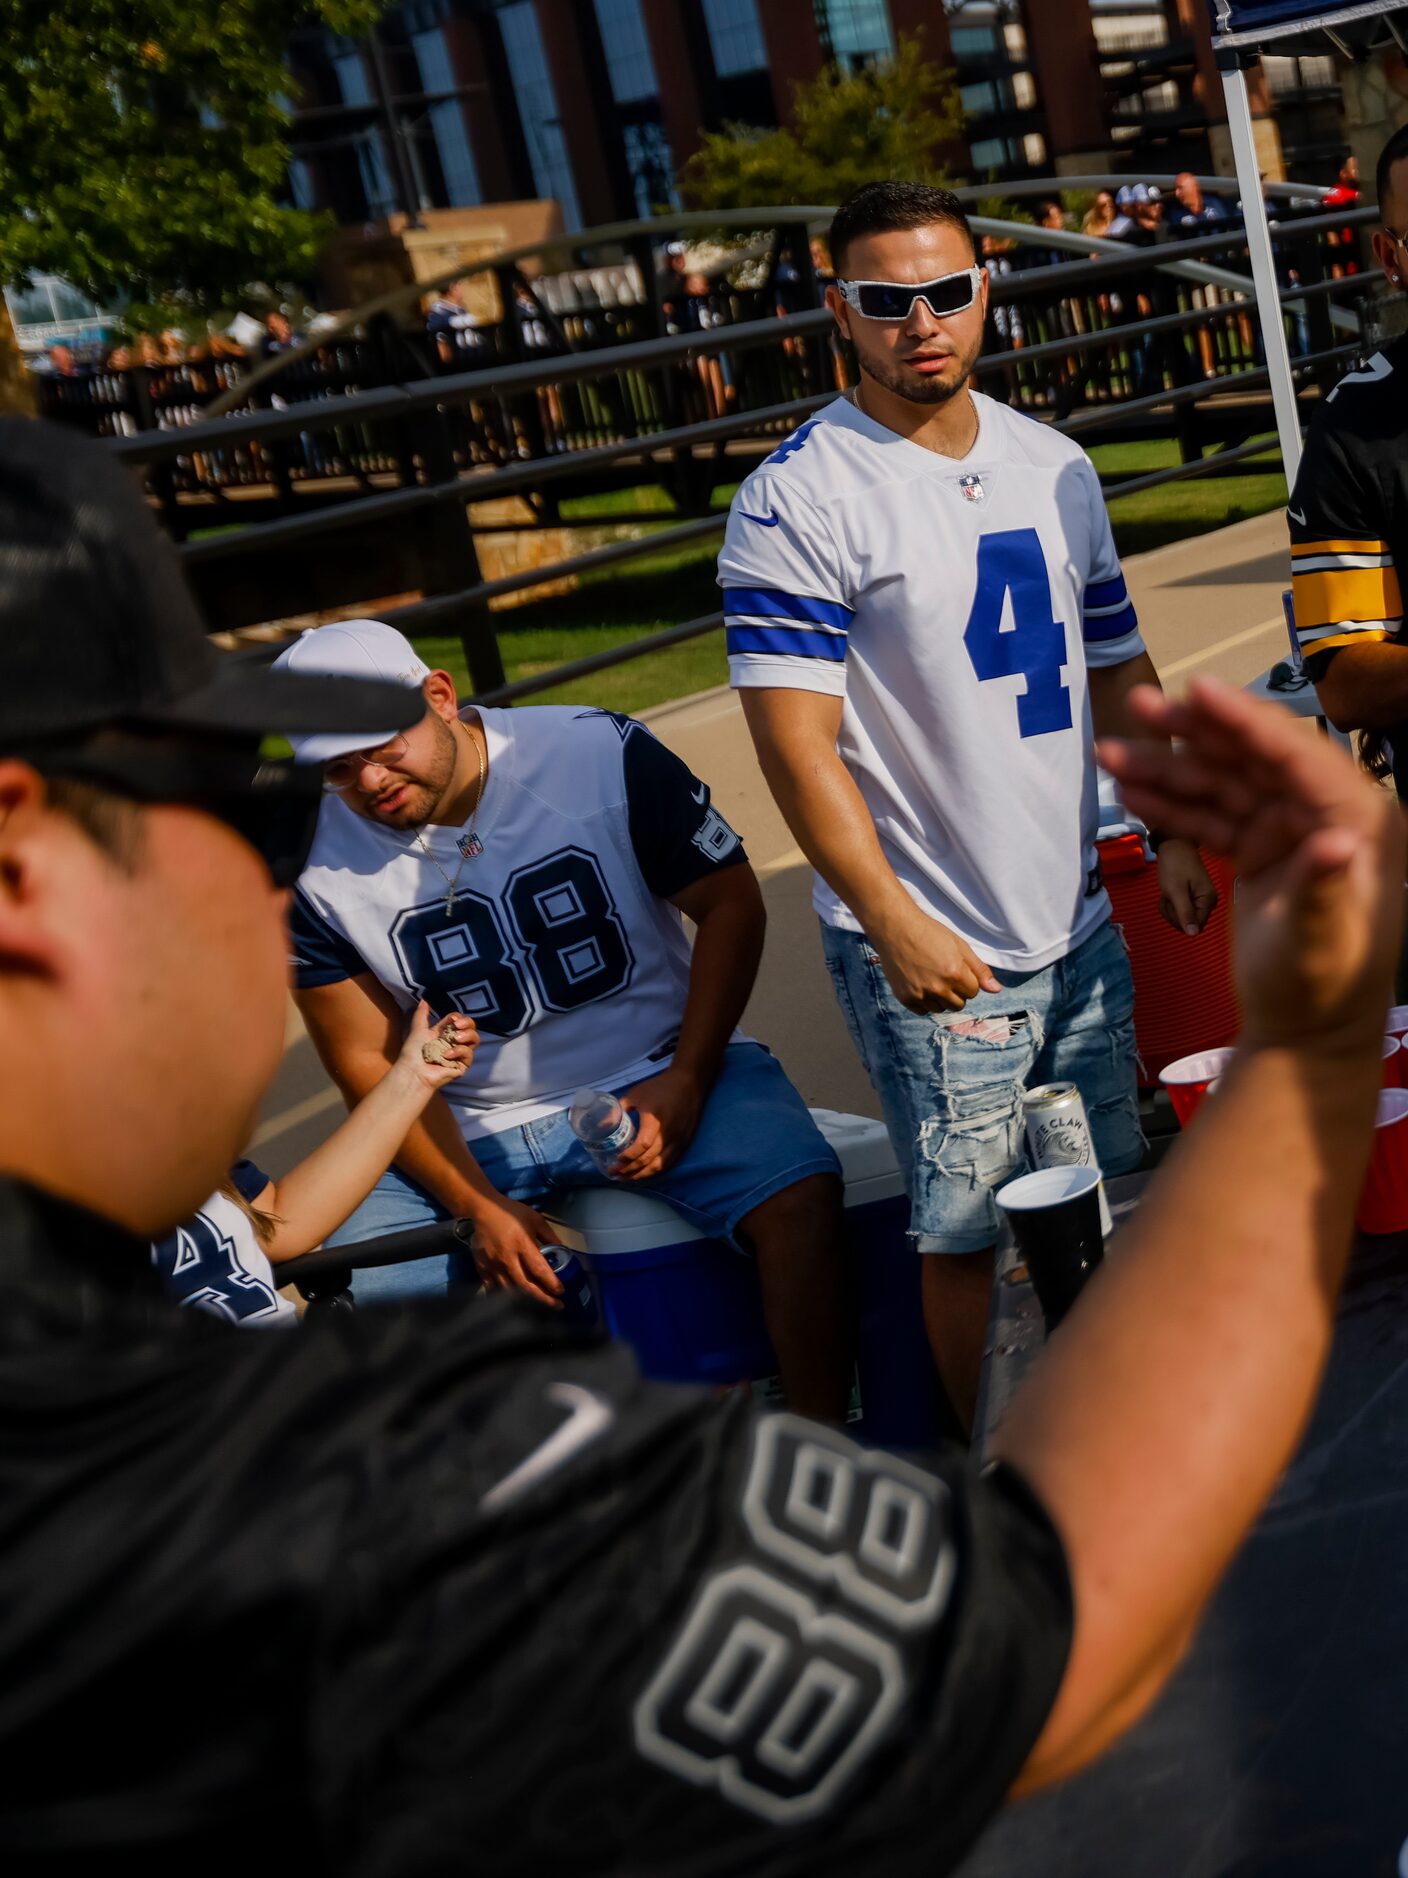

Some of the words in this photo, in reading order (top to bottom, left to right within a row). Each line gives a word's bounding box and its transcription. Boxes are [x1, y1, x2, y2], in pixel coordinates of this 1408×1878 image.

[1325, 351, 1395, 403] 7
[962, 527, 1073, 739] 4
[461, 842, 481, 857] NFL
[388, 845, 636, 1037] 88
[1049, 1117, 1083, 1130] CLAW
[150, 1211, 278, 1327] 4
[634, 1412, 957, 1827] 88
